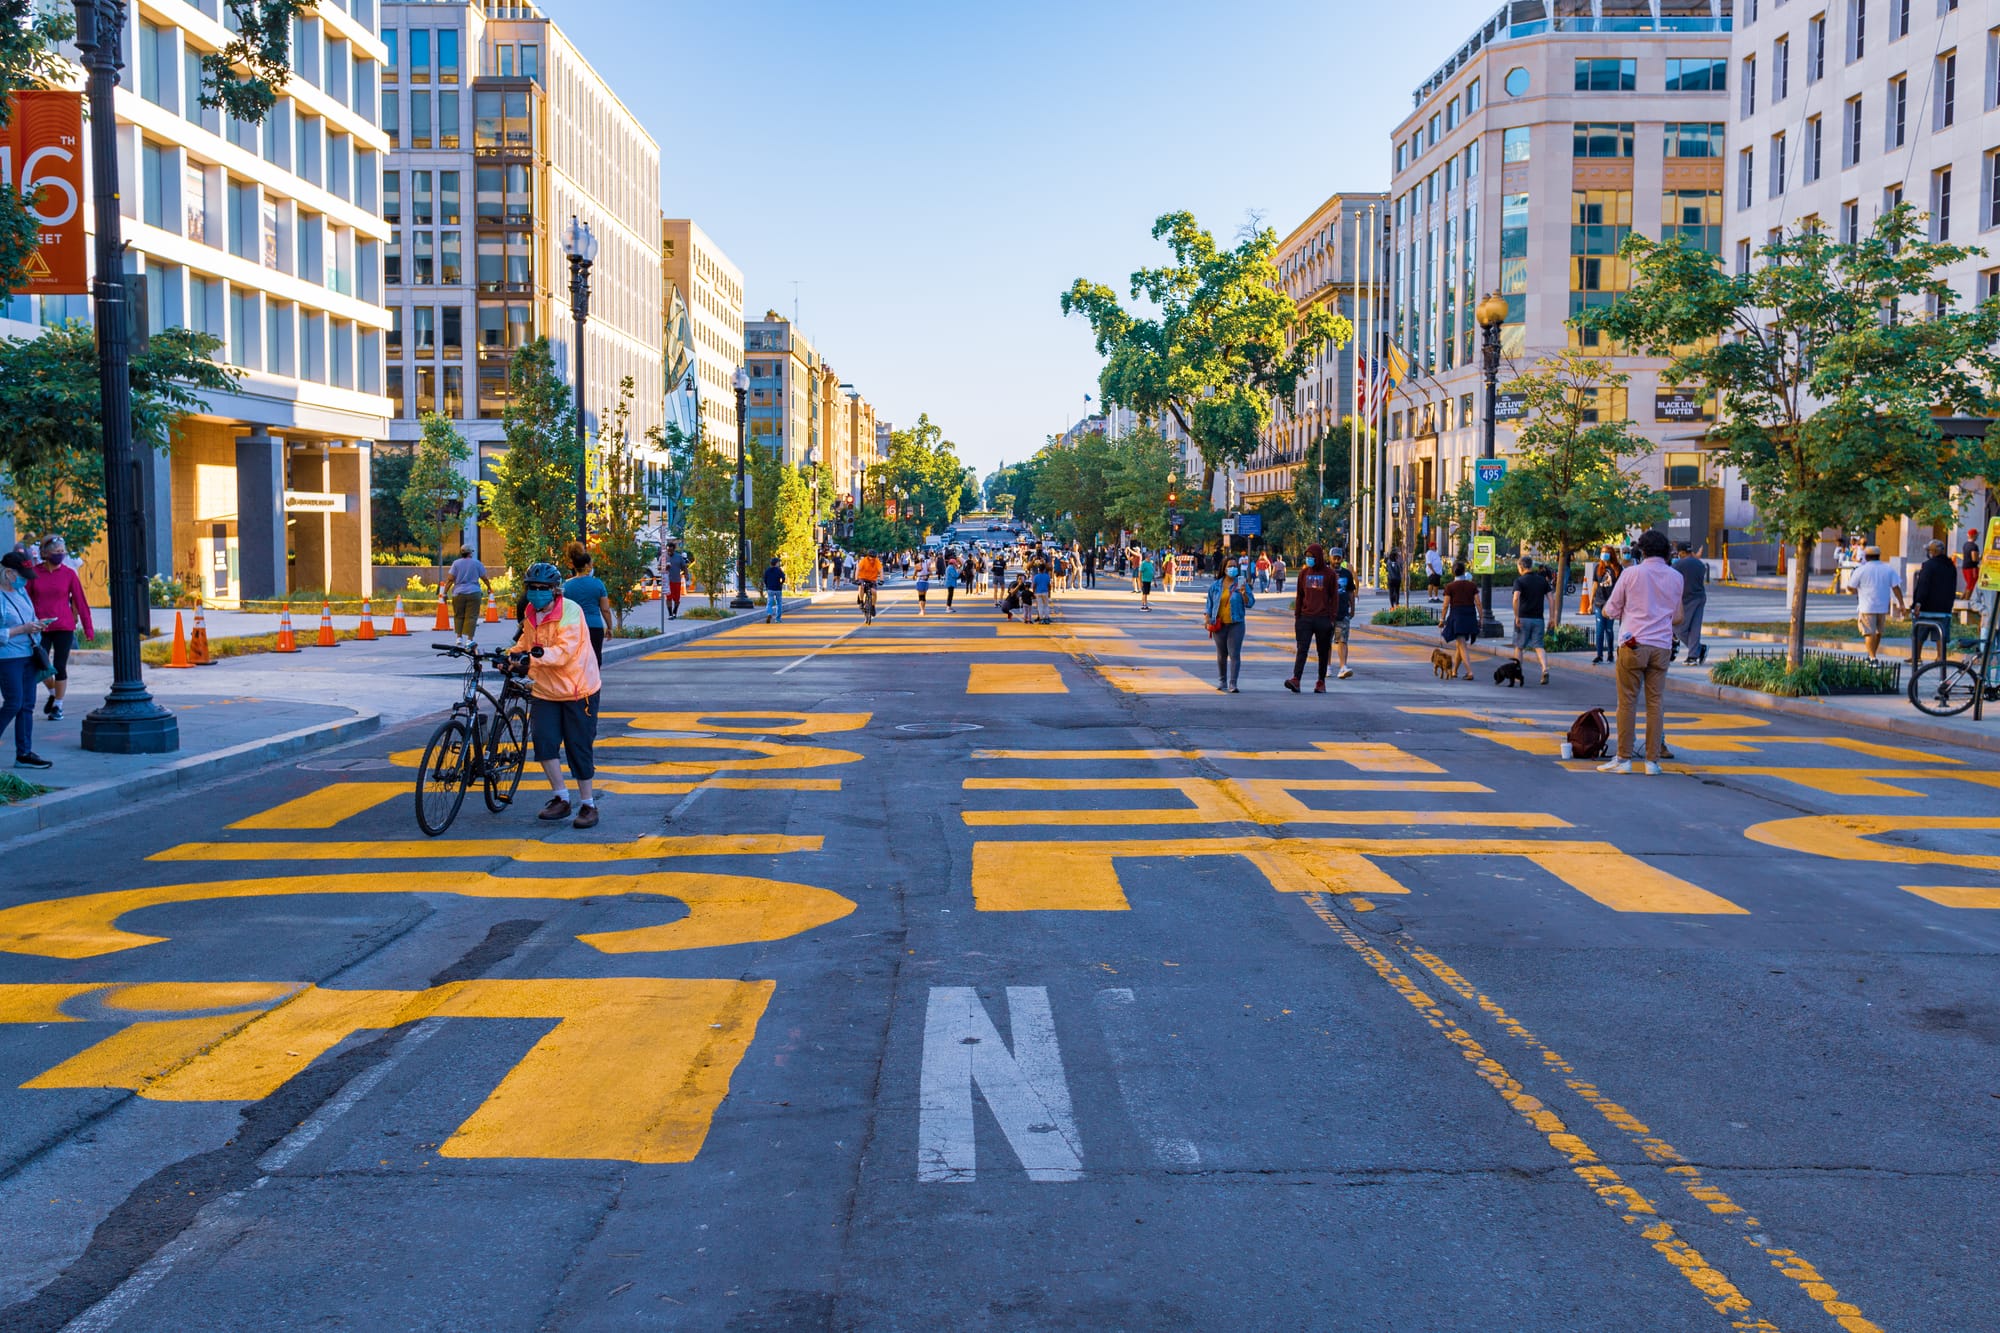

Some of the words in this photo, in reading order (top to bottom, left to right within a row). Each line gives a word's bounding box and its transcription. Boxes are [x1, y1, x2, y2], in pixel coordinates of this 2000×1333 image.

[60, 136, 76, 145] TH
[38, 233, 63, 244] EET
[1658, 401, 1680, 409] BLACK
[1483, 469, 1499, 481] 495
[962, 742, 1751, 914] THE
